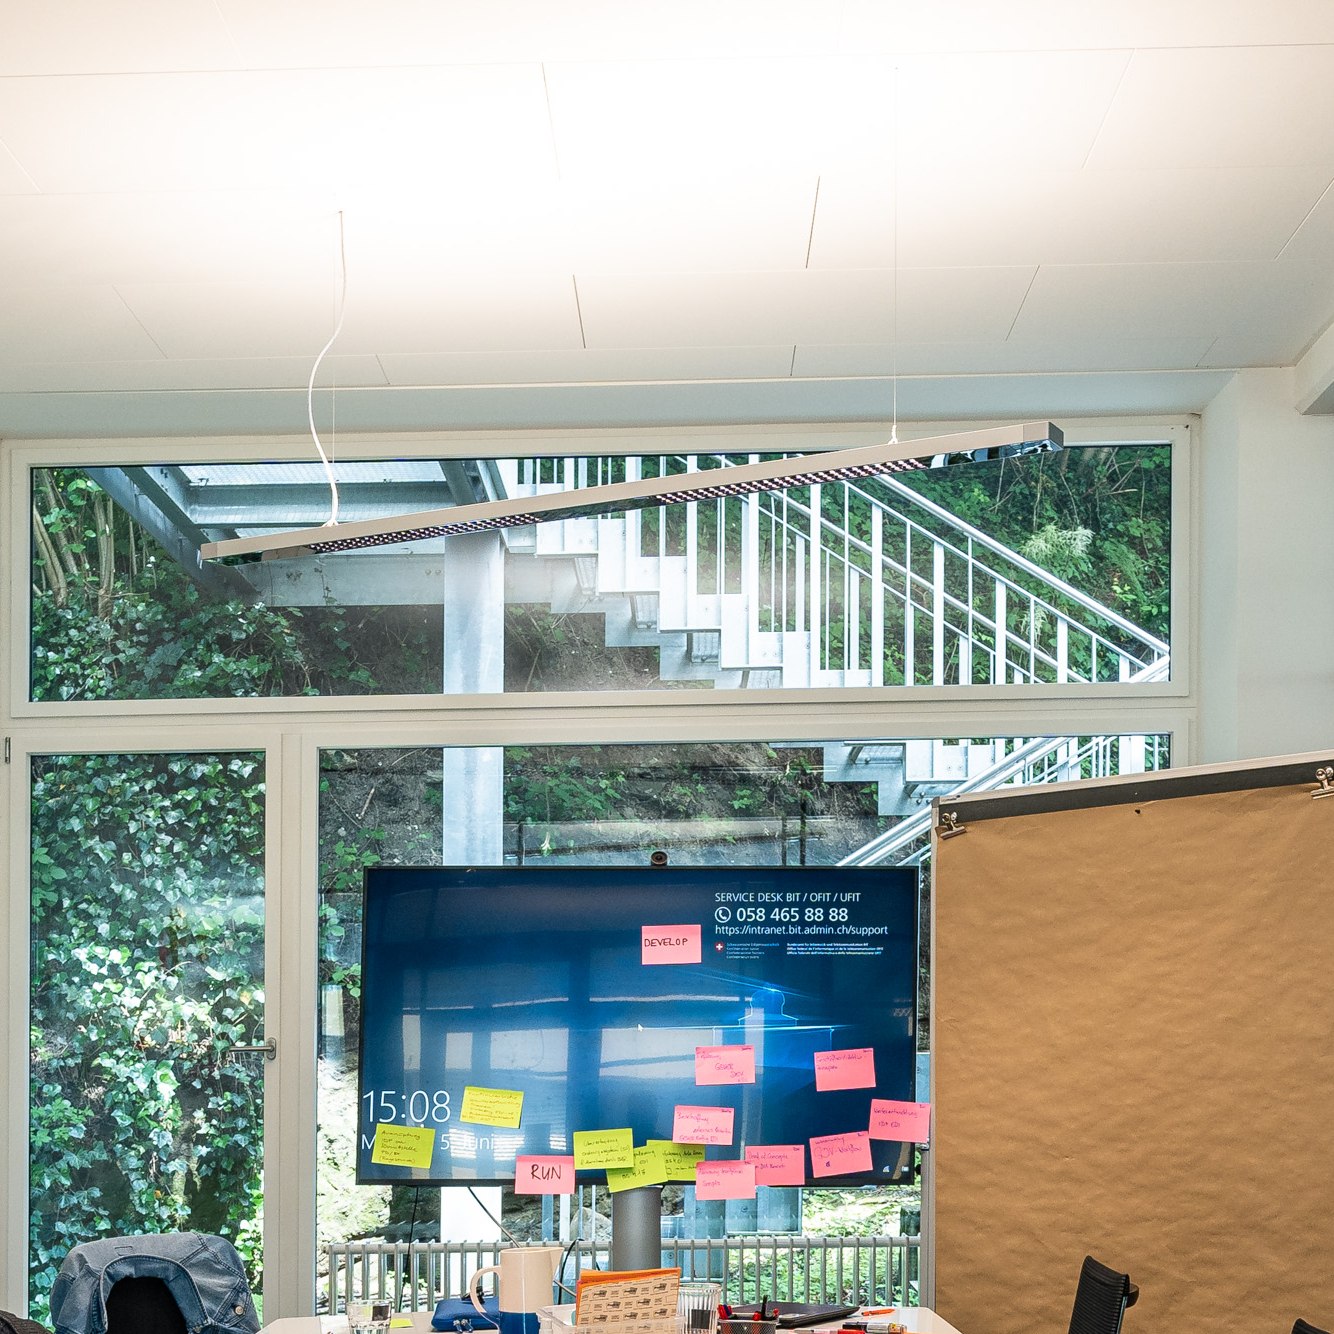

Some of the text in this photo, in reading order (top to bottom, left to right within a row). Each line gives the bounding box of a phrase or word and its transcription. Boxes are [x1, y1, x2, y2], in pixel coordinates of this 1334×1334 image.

[715, 893, 861, 902] SERVICE DESK BIT / OFIT / UFIT
[736, 908, 848, 922] 058 465 88 88
[715, 925, 888, 936] https://intranet.bit.admin.ch/support
[644, 938, 688, 947] DEVELOP
[363, 1090, 451, 1122] 15:08
[531, 1164, 561, 1180] RUN
